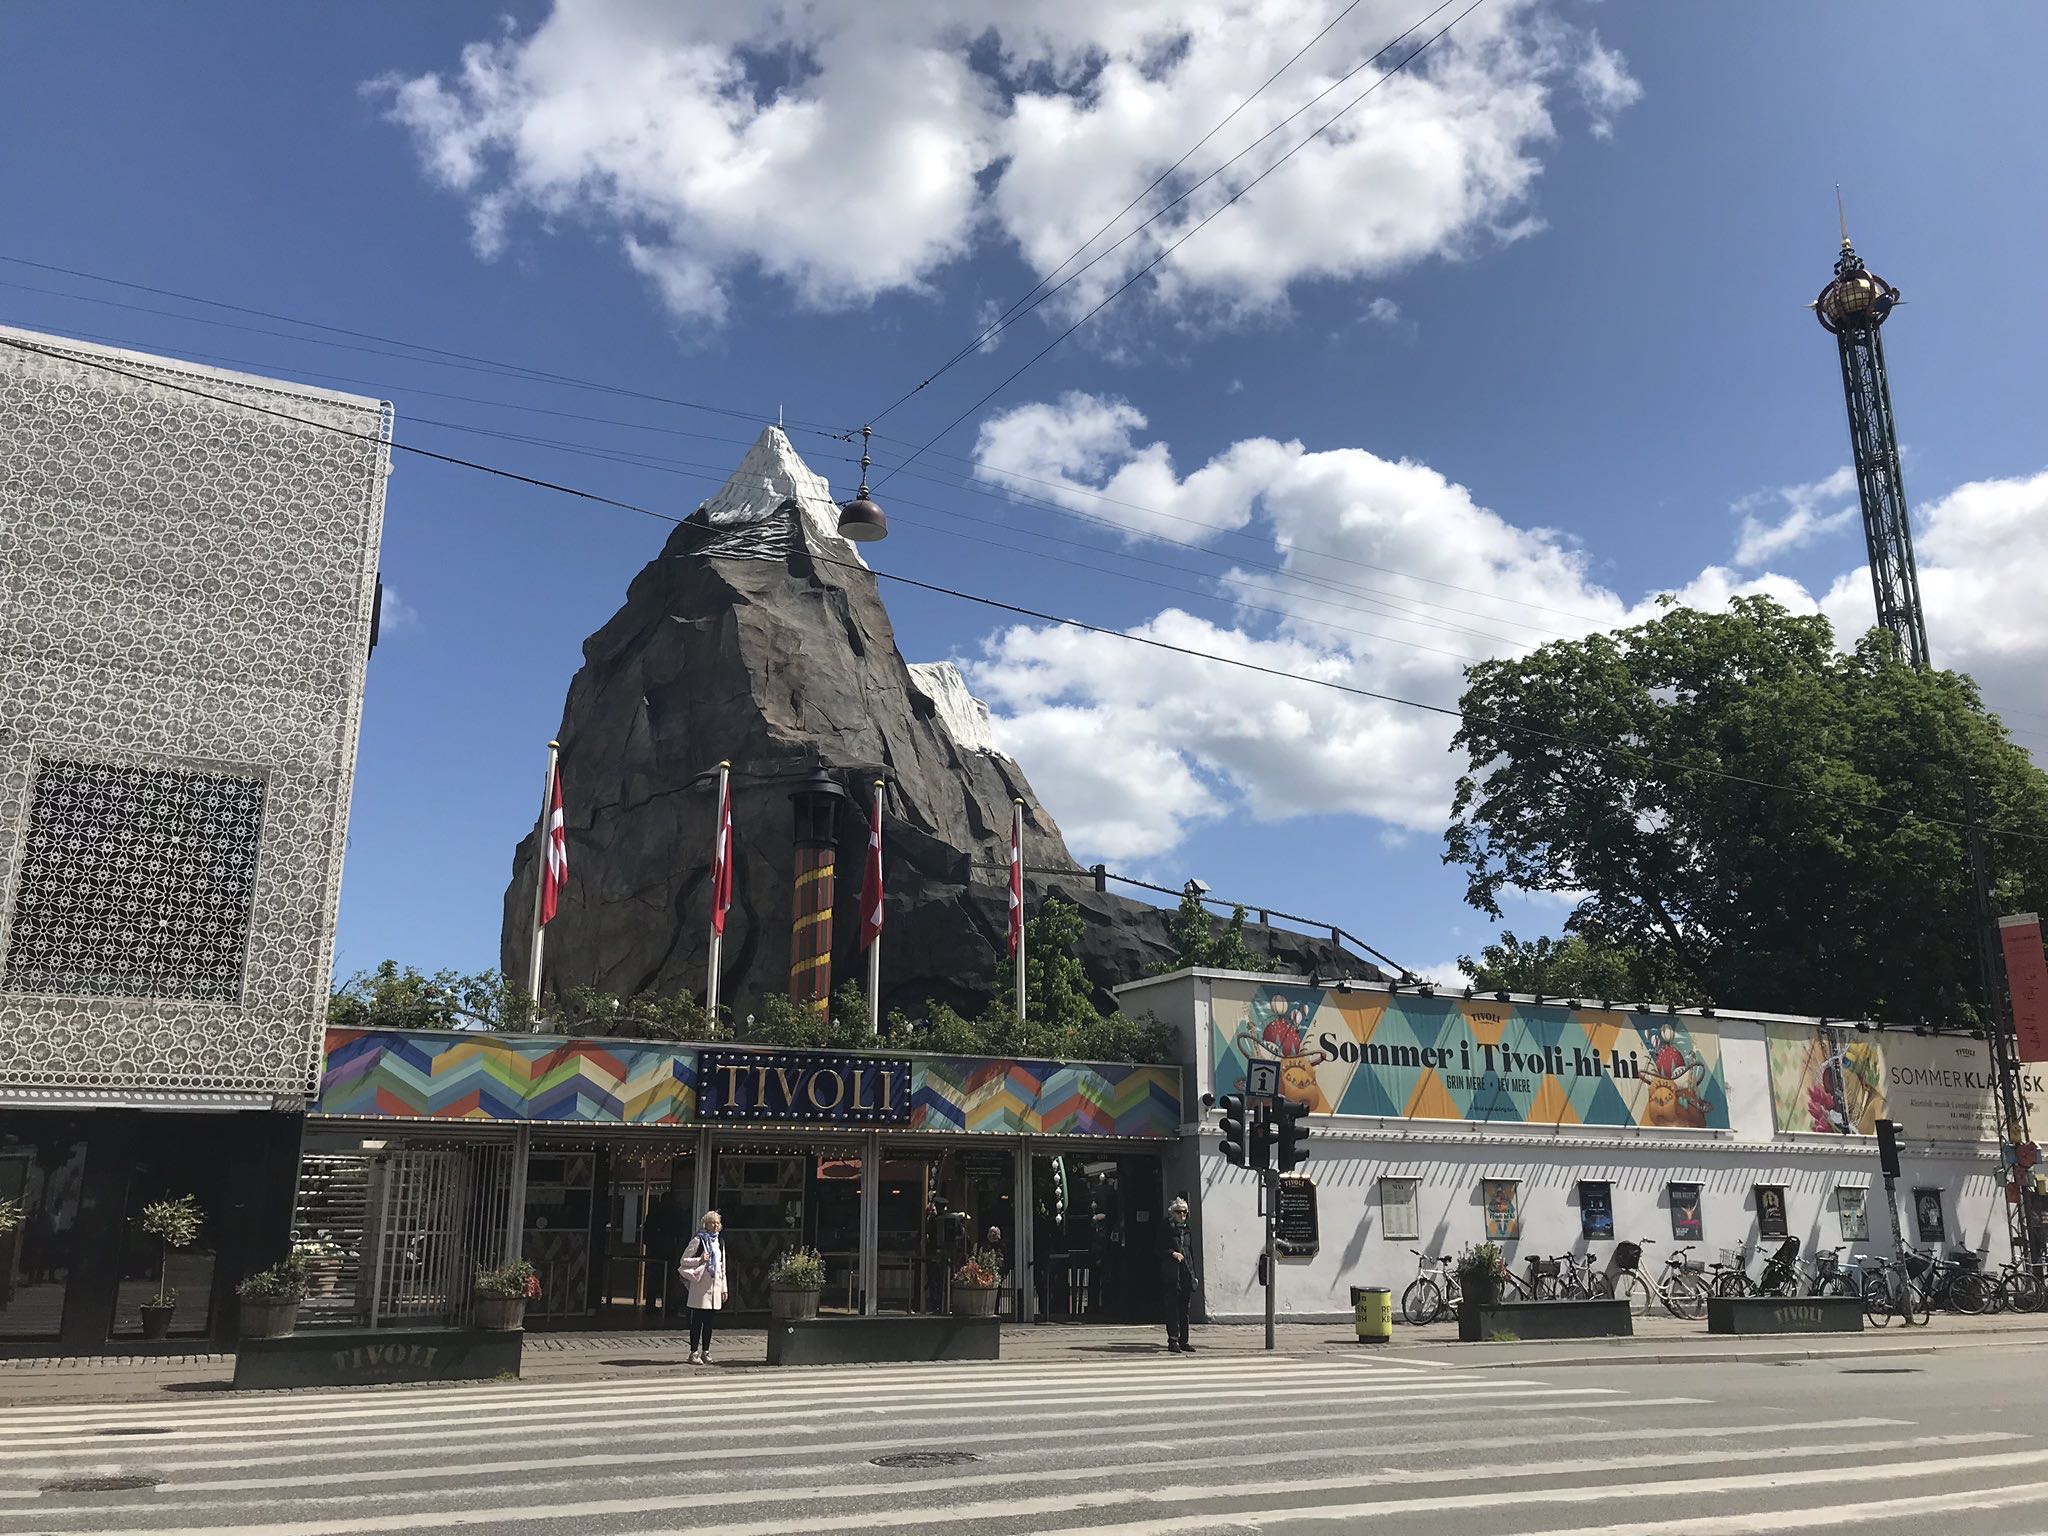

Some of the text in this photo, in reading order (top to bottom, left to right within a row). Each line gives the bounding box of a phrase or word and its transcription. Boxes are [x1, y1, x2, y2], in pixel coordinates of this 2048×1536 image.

[1471, 1012, 1501, 1023] TIVOLI
[1319, 1032, 1640, 1079] Sommer i Tivoli-hi-hi
[1955, 1048, 1976, 1057] TIVOLI
[716, 1063, 895, 1111] TIVOLI
[1446, 1075, 1531, 1093] GRIN MERE LEV MERE
[1891, 1066, 2045, 1093] SOMMERKLASSK
[1285, 1179, 1305, 1187] TIVOLI
[1774, 1305, 1824, 1324] TIVOLI
[332, 1343, 438, 1371] TIVOLI
